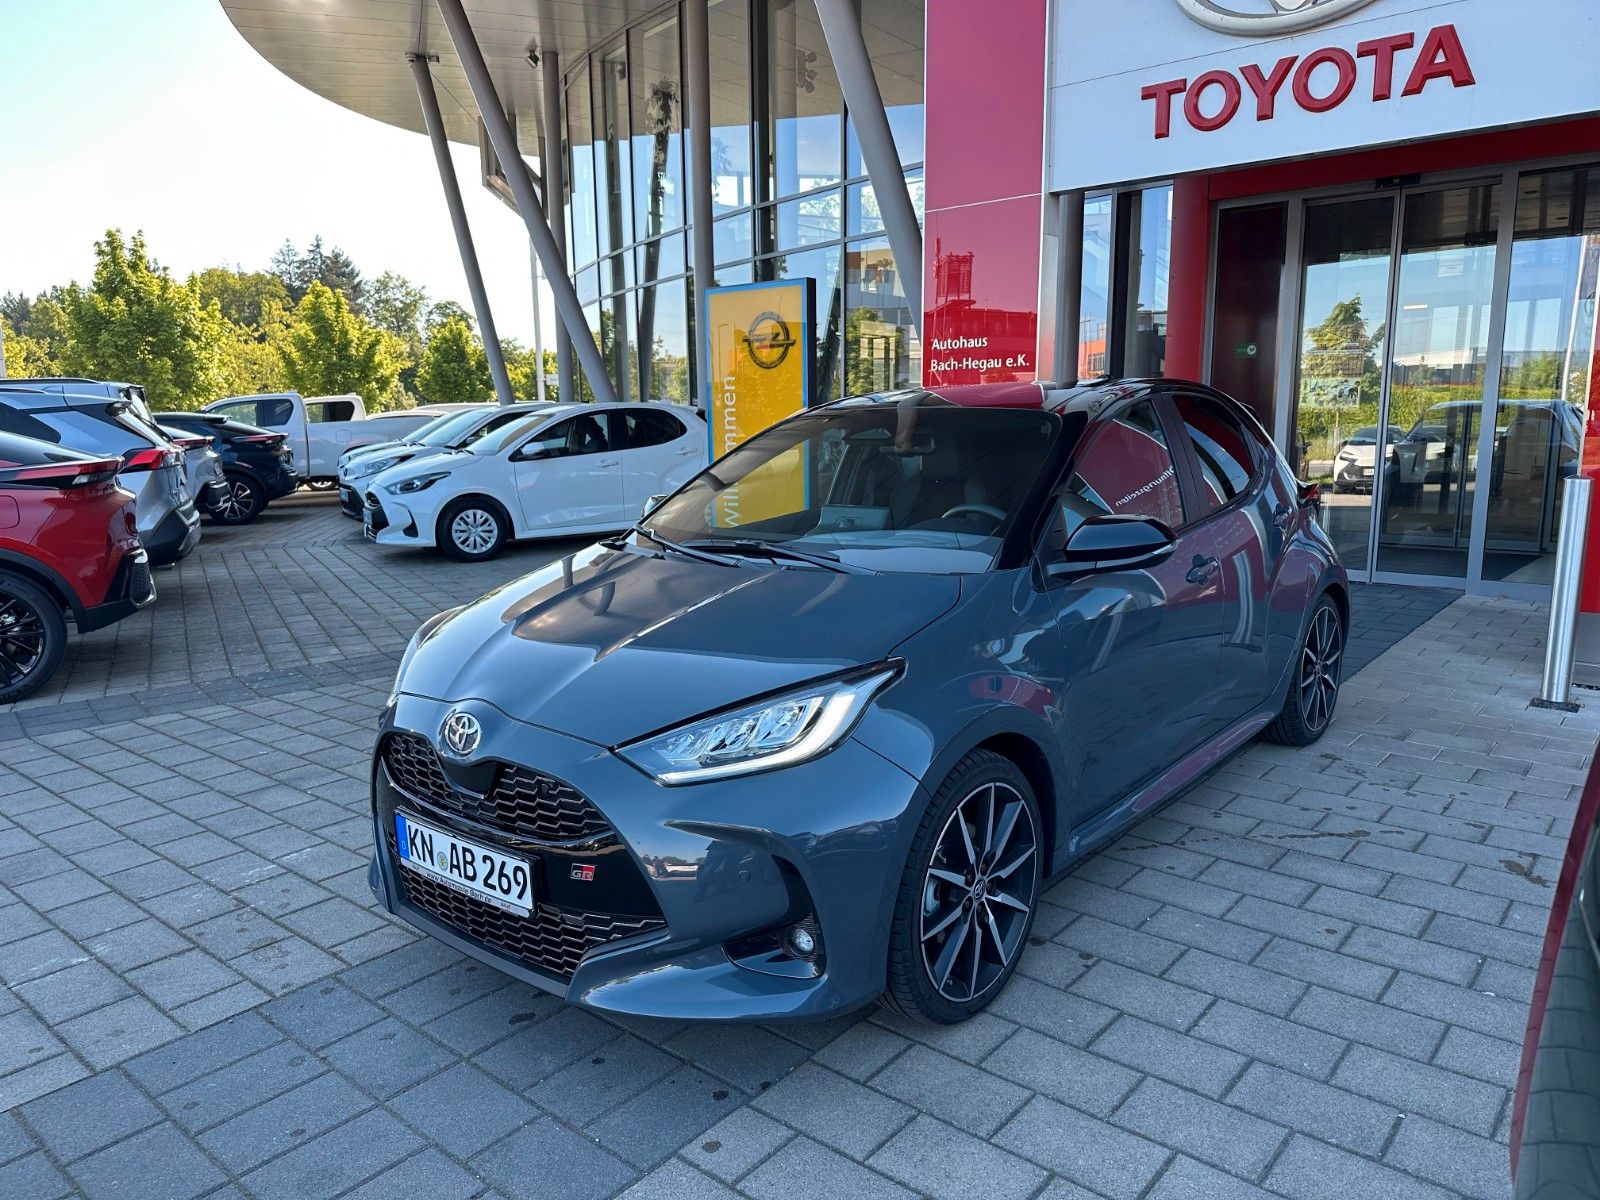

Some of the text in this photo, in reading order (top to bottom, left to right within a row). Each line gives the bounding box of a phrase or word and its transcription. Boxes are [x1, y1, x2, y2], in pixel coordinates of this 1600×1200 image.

[1141, 24, 1475, 139] TOYOTA
[931, 336, 988, 350] Autohaus
[930, 354, 1030, 372] Bach-Hegau e.K.
[407, 824, 528, 900] KN AB 269
[571, 868, 595, 881] GR
